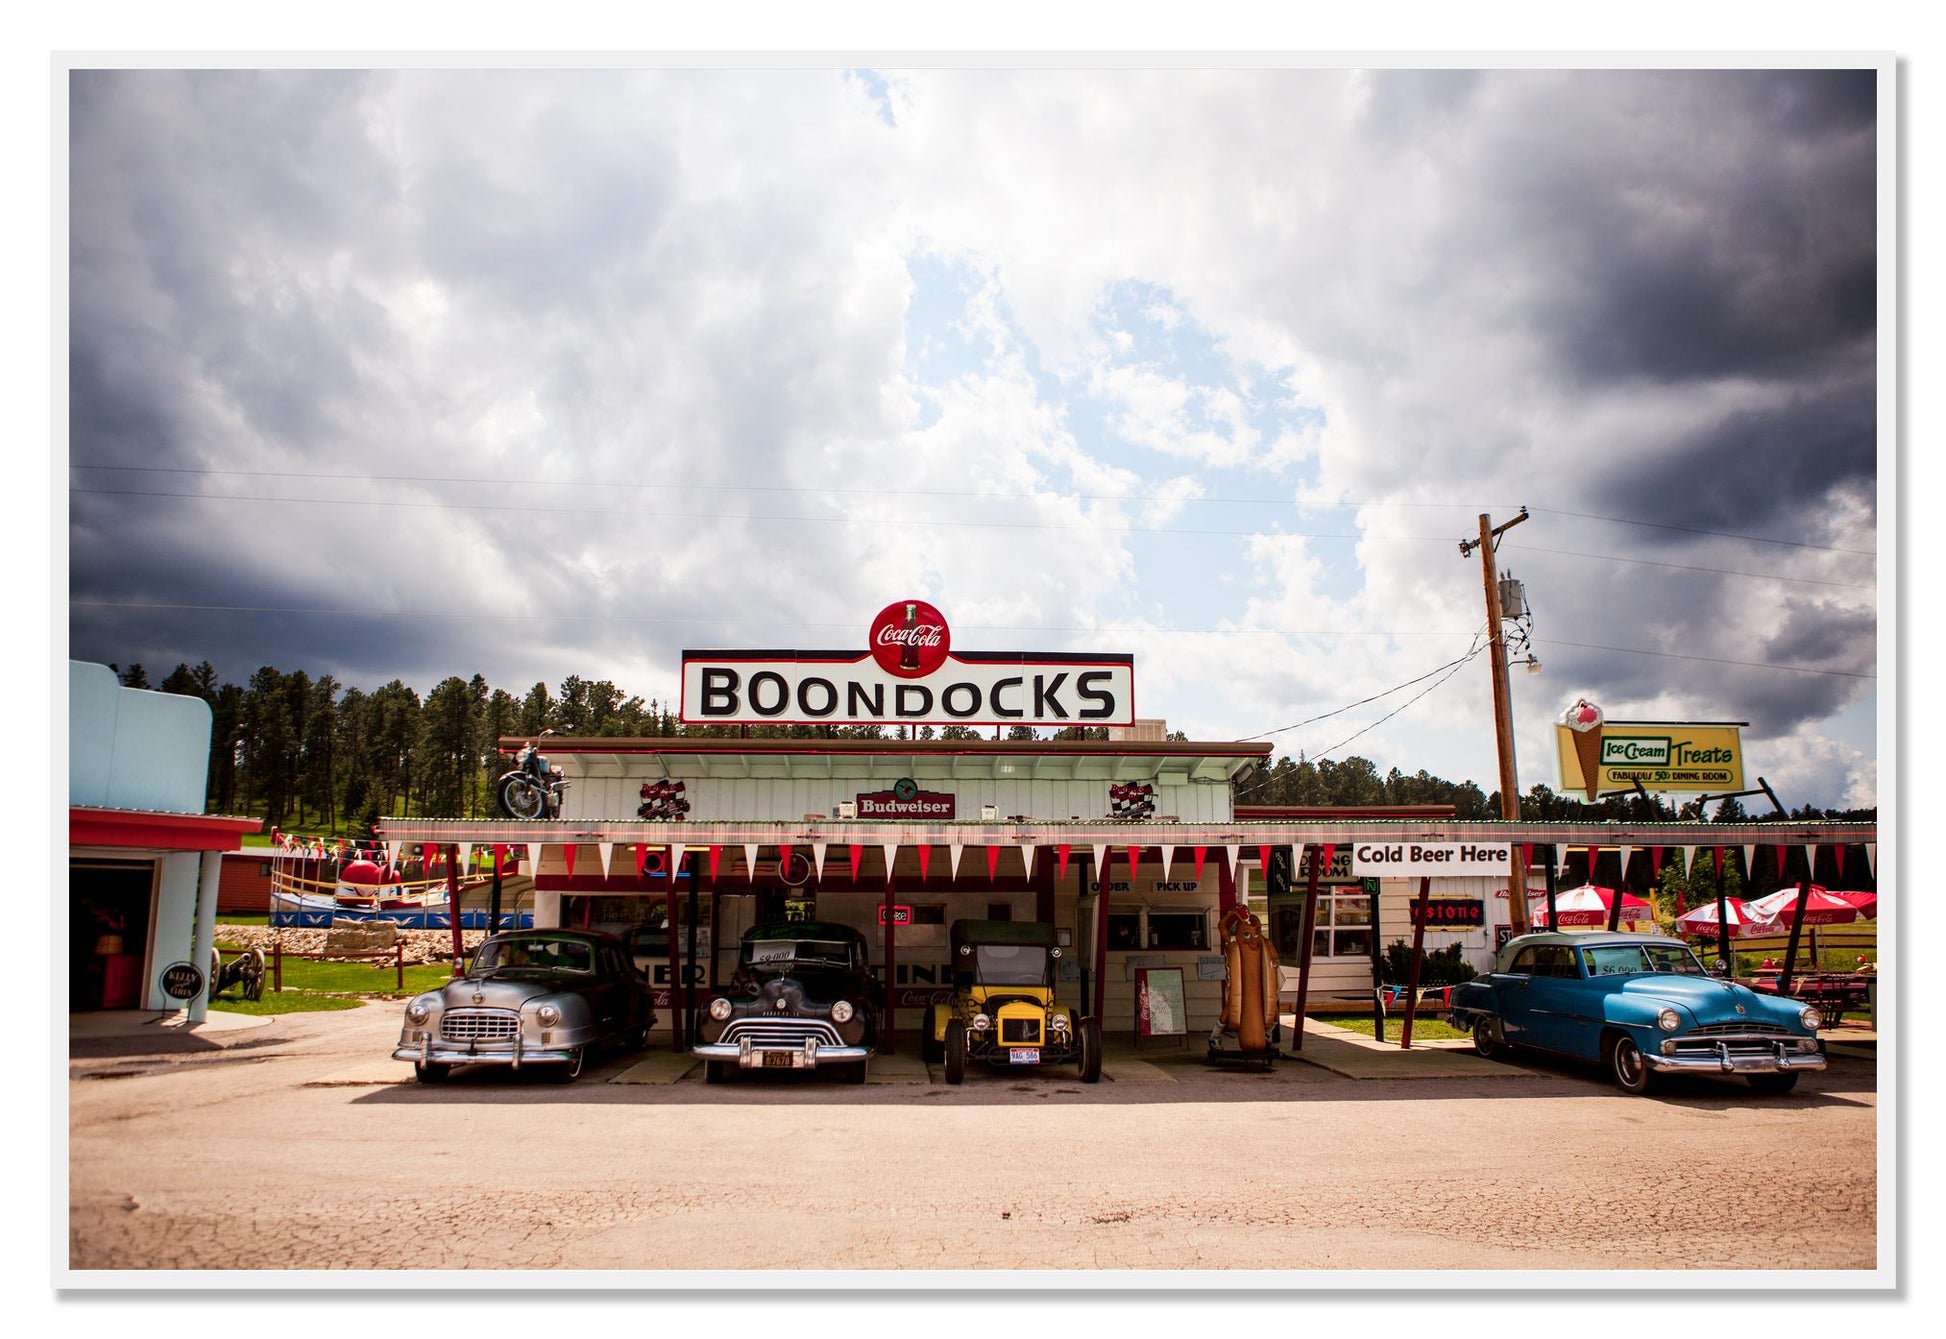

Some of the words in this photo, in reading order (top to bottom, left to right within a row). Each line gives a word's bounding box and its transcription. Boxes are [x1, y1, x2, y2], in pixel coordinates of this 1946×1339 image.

[877, 624, 944, 647] Coca-Cola
[700, 667, 1116, 719] BOONDOCKS
[1607, 742, 1625, 757] Ice
[1624, 742, 1665, 760] Cream
[1672, 741, 1733, 766] Treats
[1612, 771, 1652, 780] FABULOUS
[1672, 772, 1700, 780] DINING
[1702, 772, 1727, 781] ROOM
[861, 800, 950, 813] Budweiser
[1357, 845, 1403, 862] Cold
[1410, 845, 1454, 862] Beer
[1460, 845, 1508, 861] Here
[1092, 882, 1129, 891] ODER
[1156, 882, 1181, 891] PICK
[1184, 883, 1197, 891] UP
[882, 910, 907, 921] Cke
[1558, 912, 1590, 924] Coca-Cola
